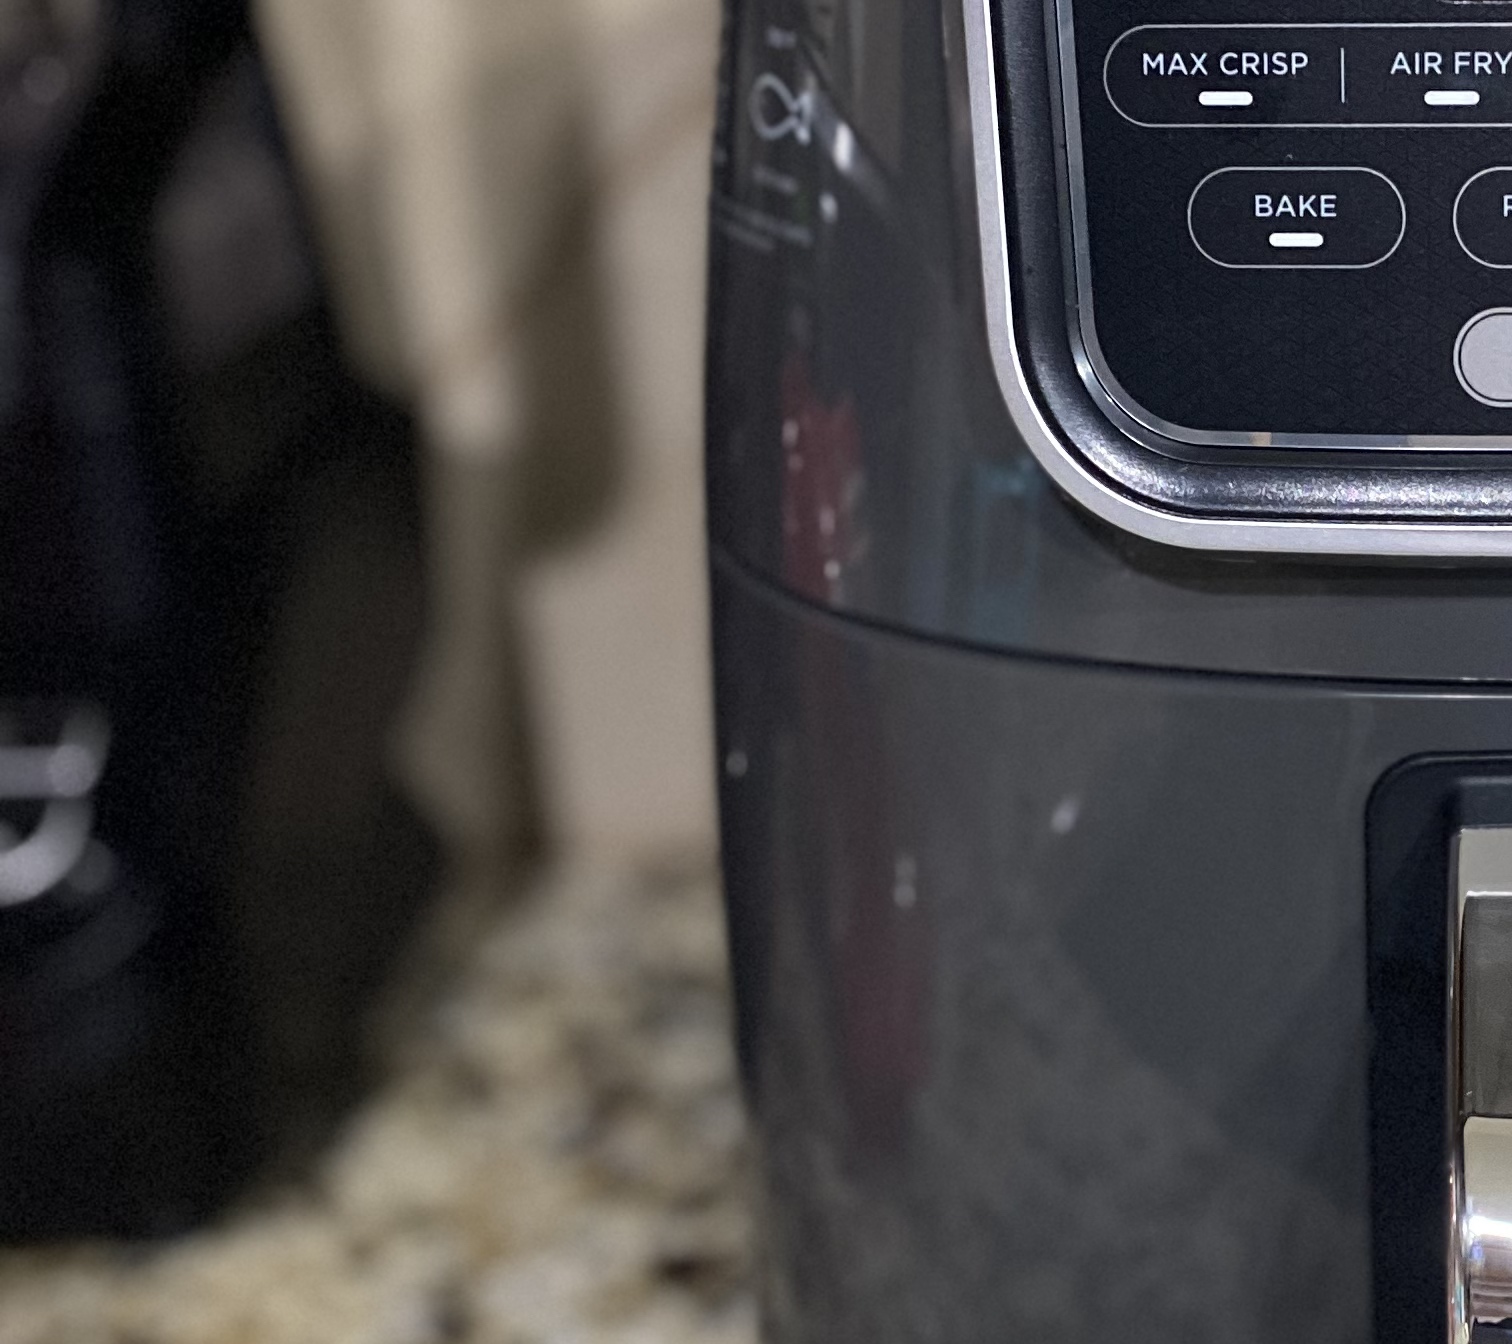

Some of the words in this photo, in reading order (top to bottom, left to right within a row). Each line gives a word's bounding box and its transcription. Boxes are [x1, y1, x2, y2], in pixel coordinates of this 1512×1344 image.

[1142, 52, 1208, 76] MAX
[1219, 52, 1309, 76] CRISP
[1390, 51, 1443, 75] AIR
[1254, 194, 1337, 218] BAKE
